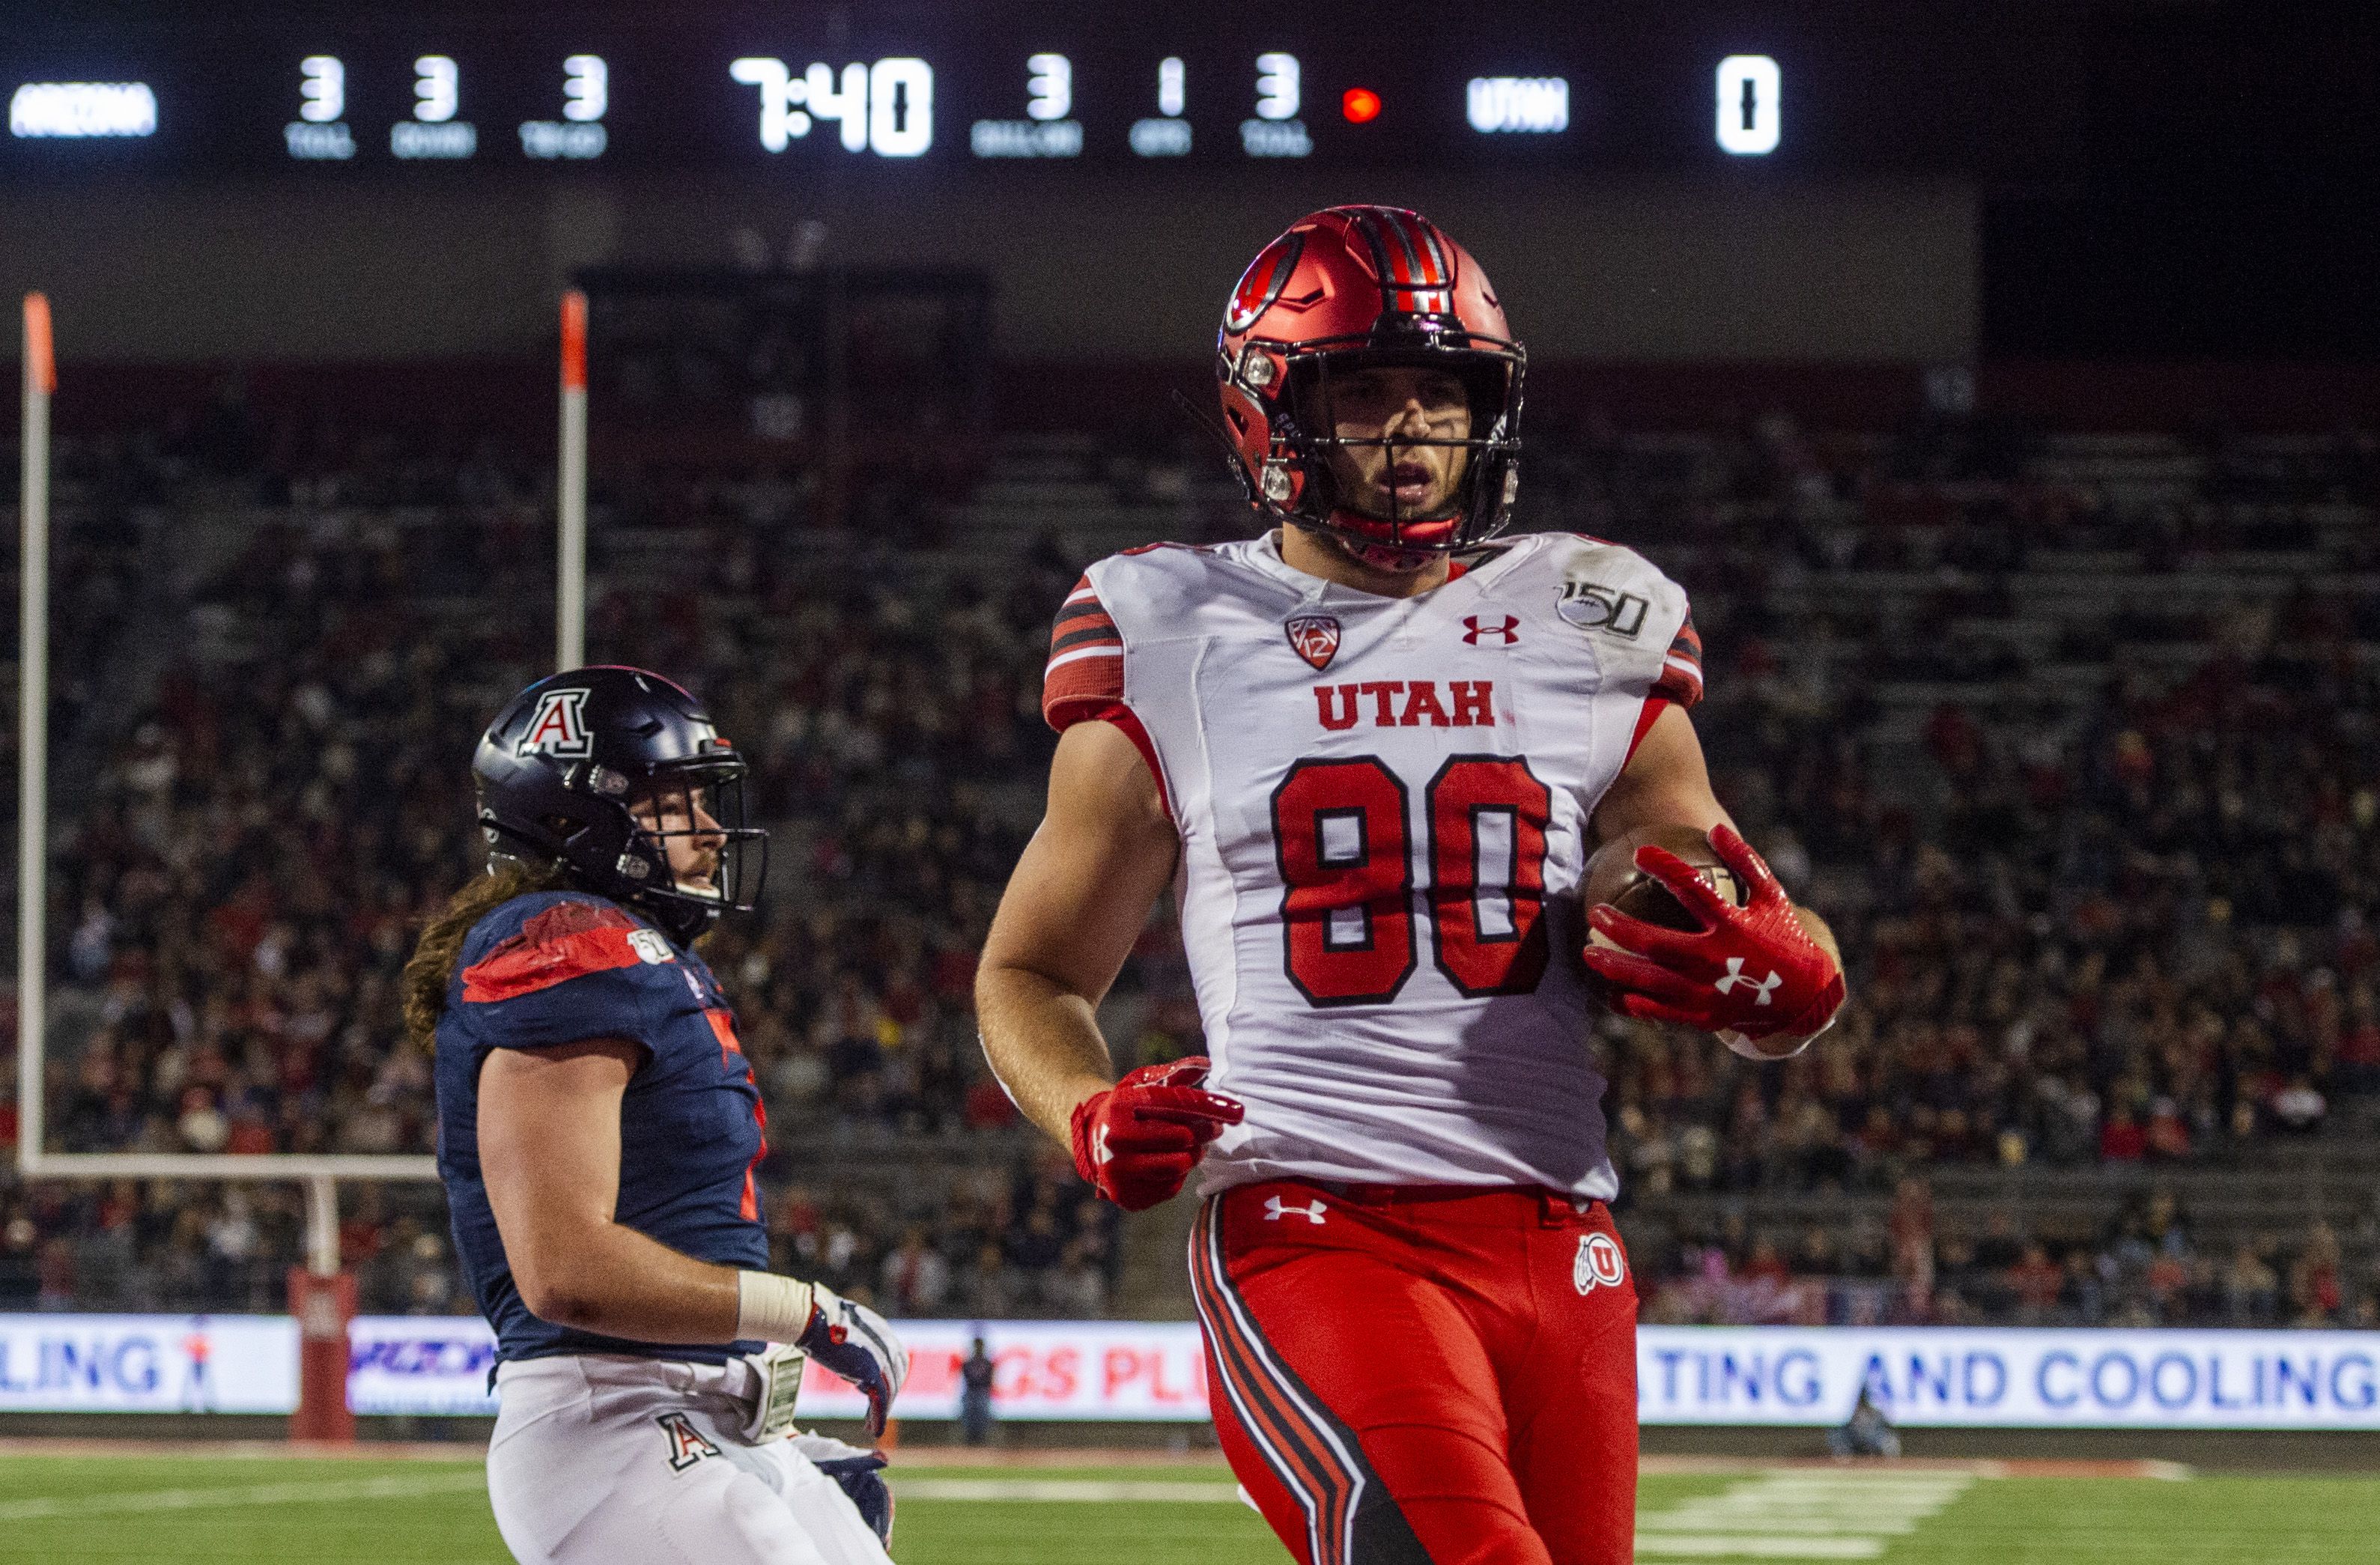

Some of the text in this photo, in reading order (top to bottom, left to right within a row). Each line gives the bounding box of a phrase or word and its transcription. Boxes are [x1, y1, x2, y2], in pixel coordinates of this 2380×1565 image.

[300, 55, 345, 121] 3
[414, 55, 458, 121] 3
[563, 55, 608, 121] 3
[729, 58, 933, 156] 7:40
[1027, 53, 1070, 120] 3
[1159, 57, 1186, 116] 1
[1255, 53, 1300, 120] 3
[1716, 55, 1782, 156] 0
[1554, 581, 1650, 640] 150
[1304, 636, 1332, 658] 12
[516, 687, 594, 758] A
[1314, 681, 1495, 732] UTAH
[1270, 753, 1552, 1008] 80
[1591, 1246, 1616, 1277] U
[1102, 1346, 1208, 1403] PL
[1640, 1348, 2379, 1411] TING AND COOLING
[656, 1411, 722, 1476] A
